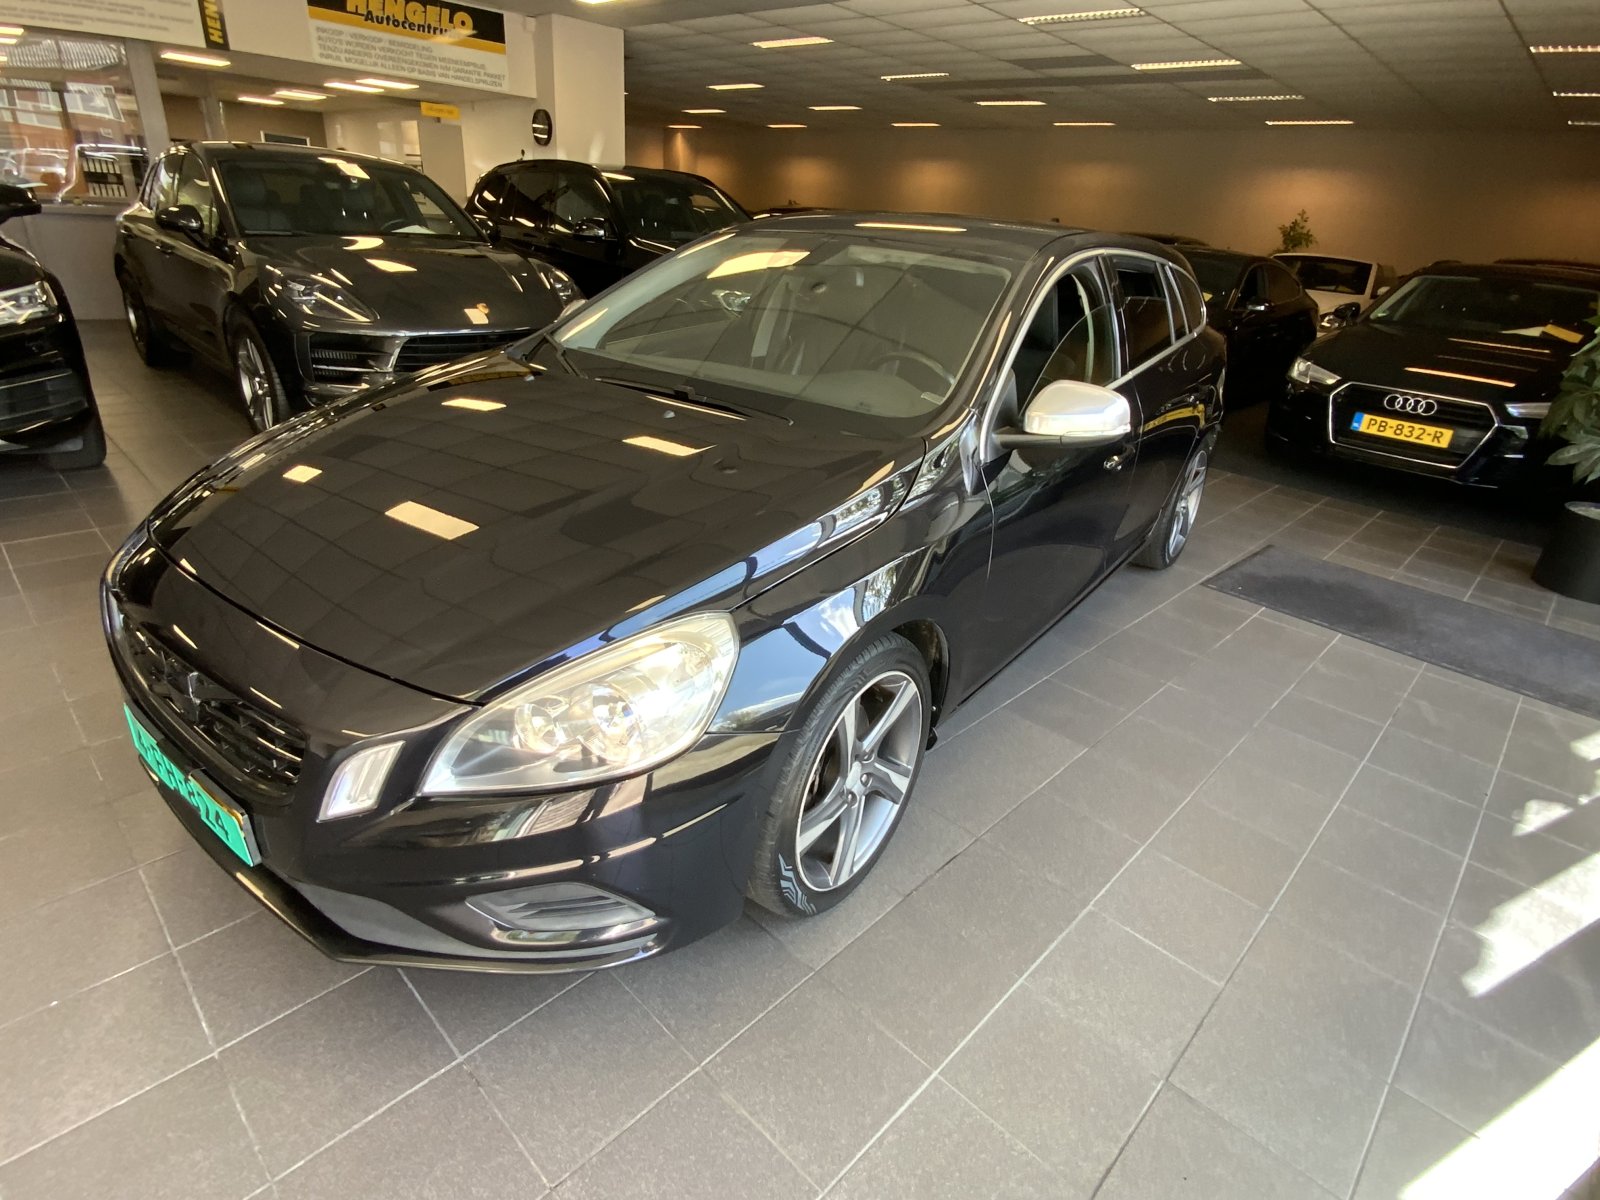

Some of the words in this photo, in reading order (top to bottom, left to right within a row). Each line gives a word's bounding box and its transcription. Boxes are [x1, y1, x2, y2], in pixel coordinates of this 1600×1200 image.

[203, 0, 224, 44] HEN
[346, 0, 474, 32] HENGELO
[1366, 418, 1444, 444] PB-832-R
